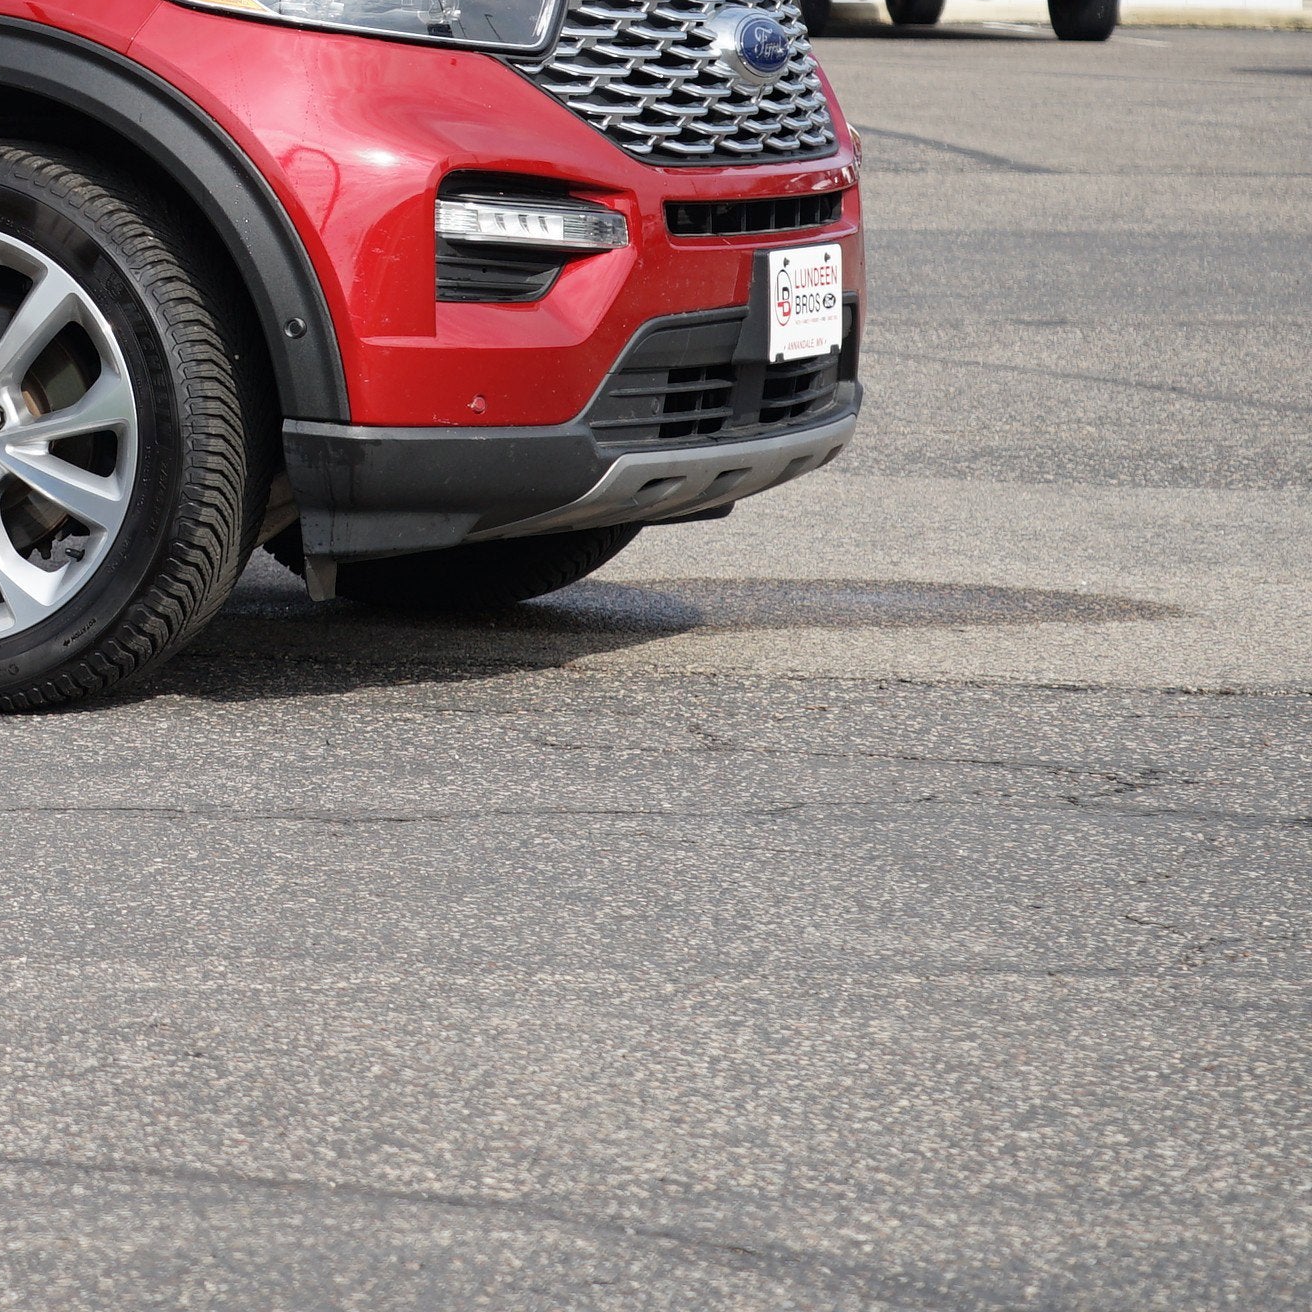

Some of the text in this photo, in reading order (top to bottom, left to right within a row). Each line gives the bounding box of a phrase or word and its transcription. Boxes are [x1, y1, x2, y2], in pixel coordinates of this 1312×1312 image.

[754, 26, 785, 59] Ford
[794, 265, 838, 289] LUNDEEN
[795, 292, 821, 315] BROS
